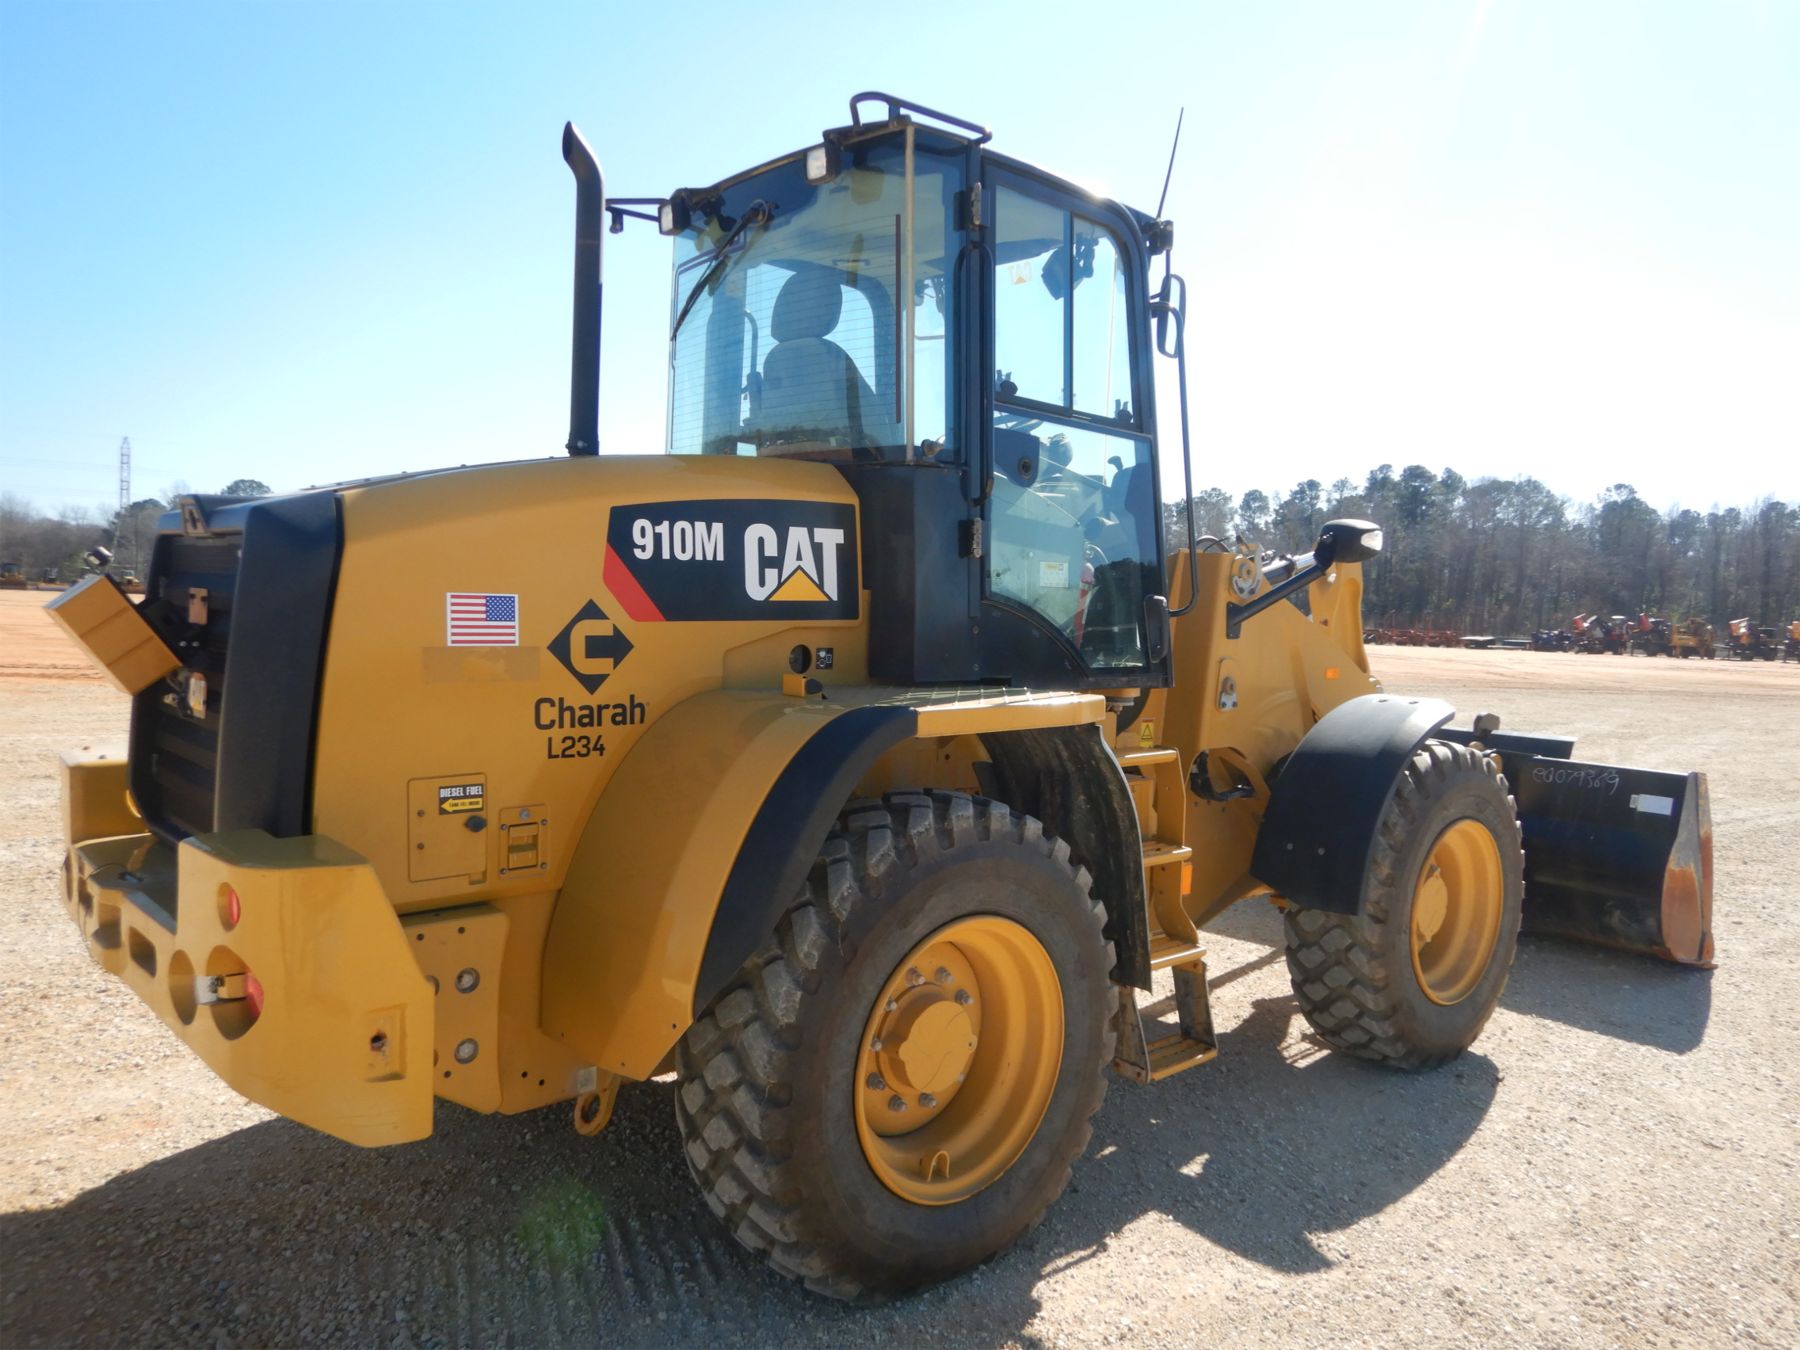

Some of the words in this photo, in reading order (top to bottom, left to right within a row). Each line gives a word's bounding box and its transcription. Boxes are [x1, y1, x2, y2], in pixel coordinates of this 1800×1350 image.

[632, 519, 724, 561] 910M
[744, 523, 845, 601] CAT
[534, 694, 646, 731] Charah
[547, 735, 605, 759] L234
[440, 787, 464, 798] DIESEL
[466, 785, 483, 796] FUEL
